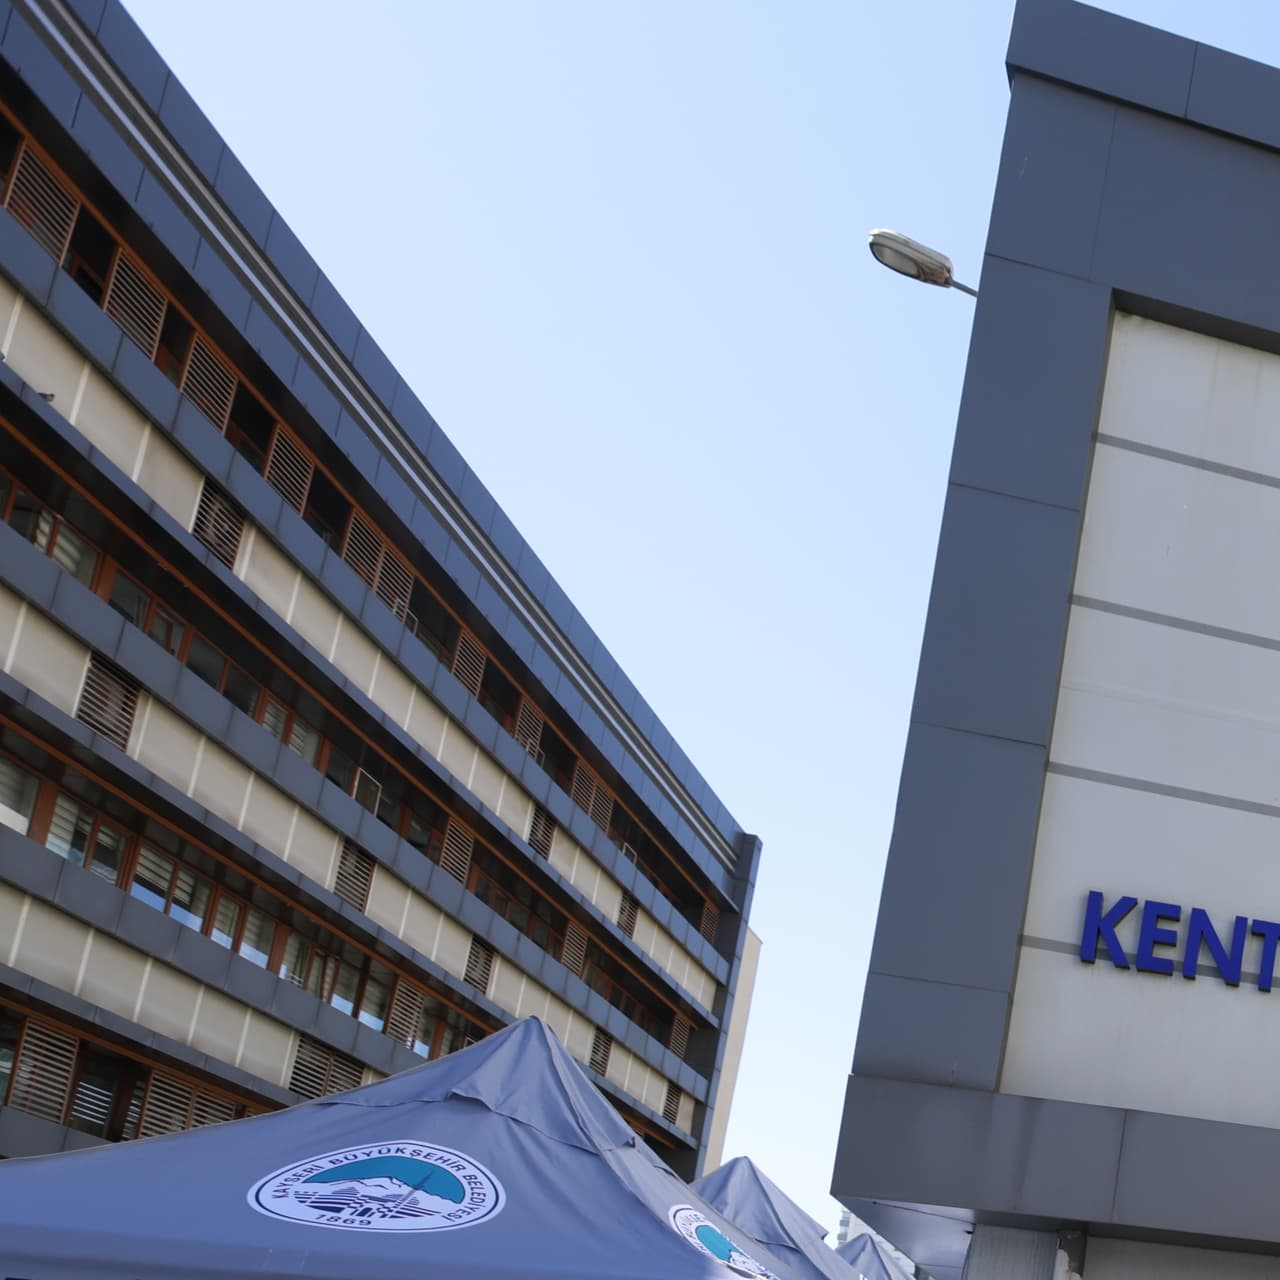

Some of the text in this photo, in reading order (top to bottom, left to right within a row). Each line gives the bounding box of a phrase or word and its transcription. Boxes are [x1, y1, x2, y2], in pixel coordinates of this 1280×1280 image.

[328, 1146, 466, 1173] BÜYÜKŞEHİR
[440, 1173, 487, 1223] BELEDİYESİ
[315, 1213, 373, 1226] 1869
